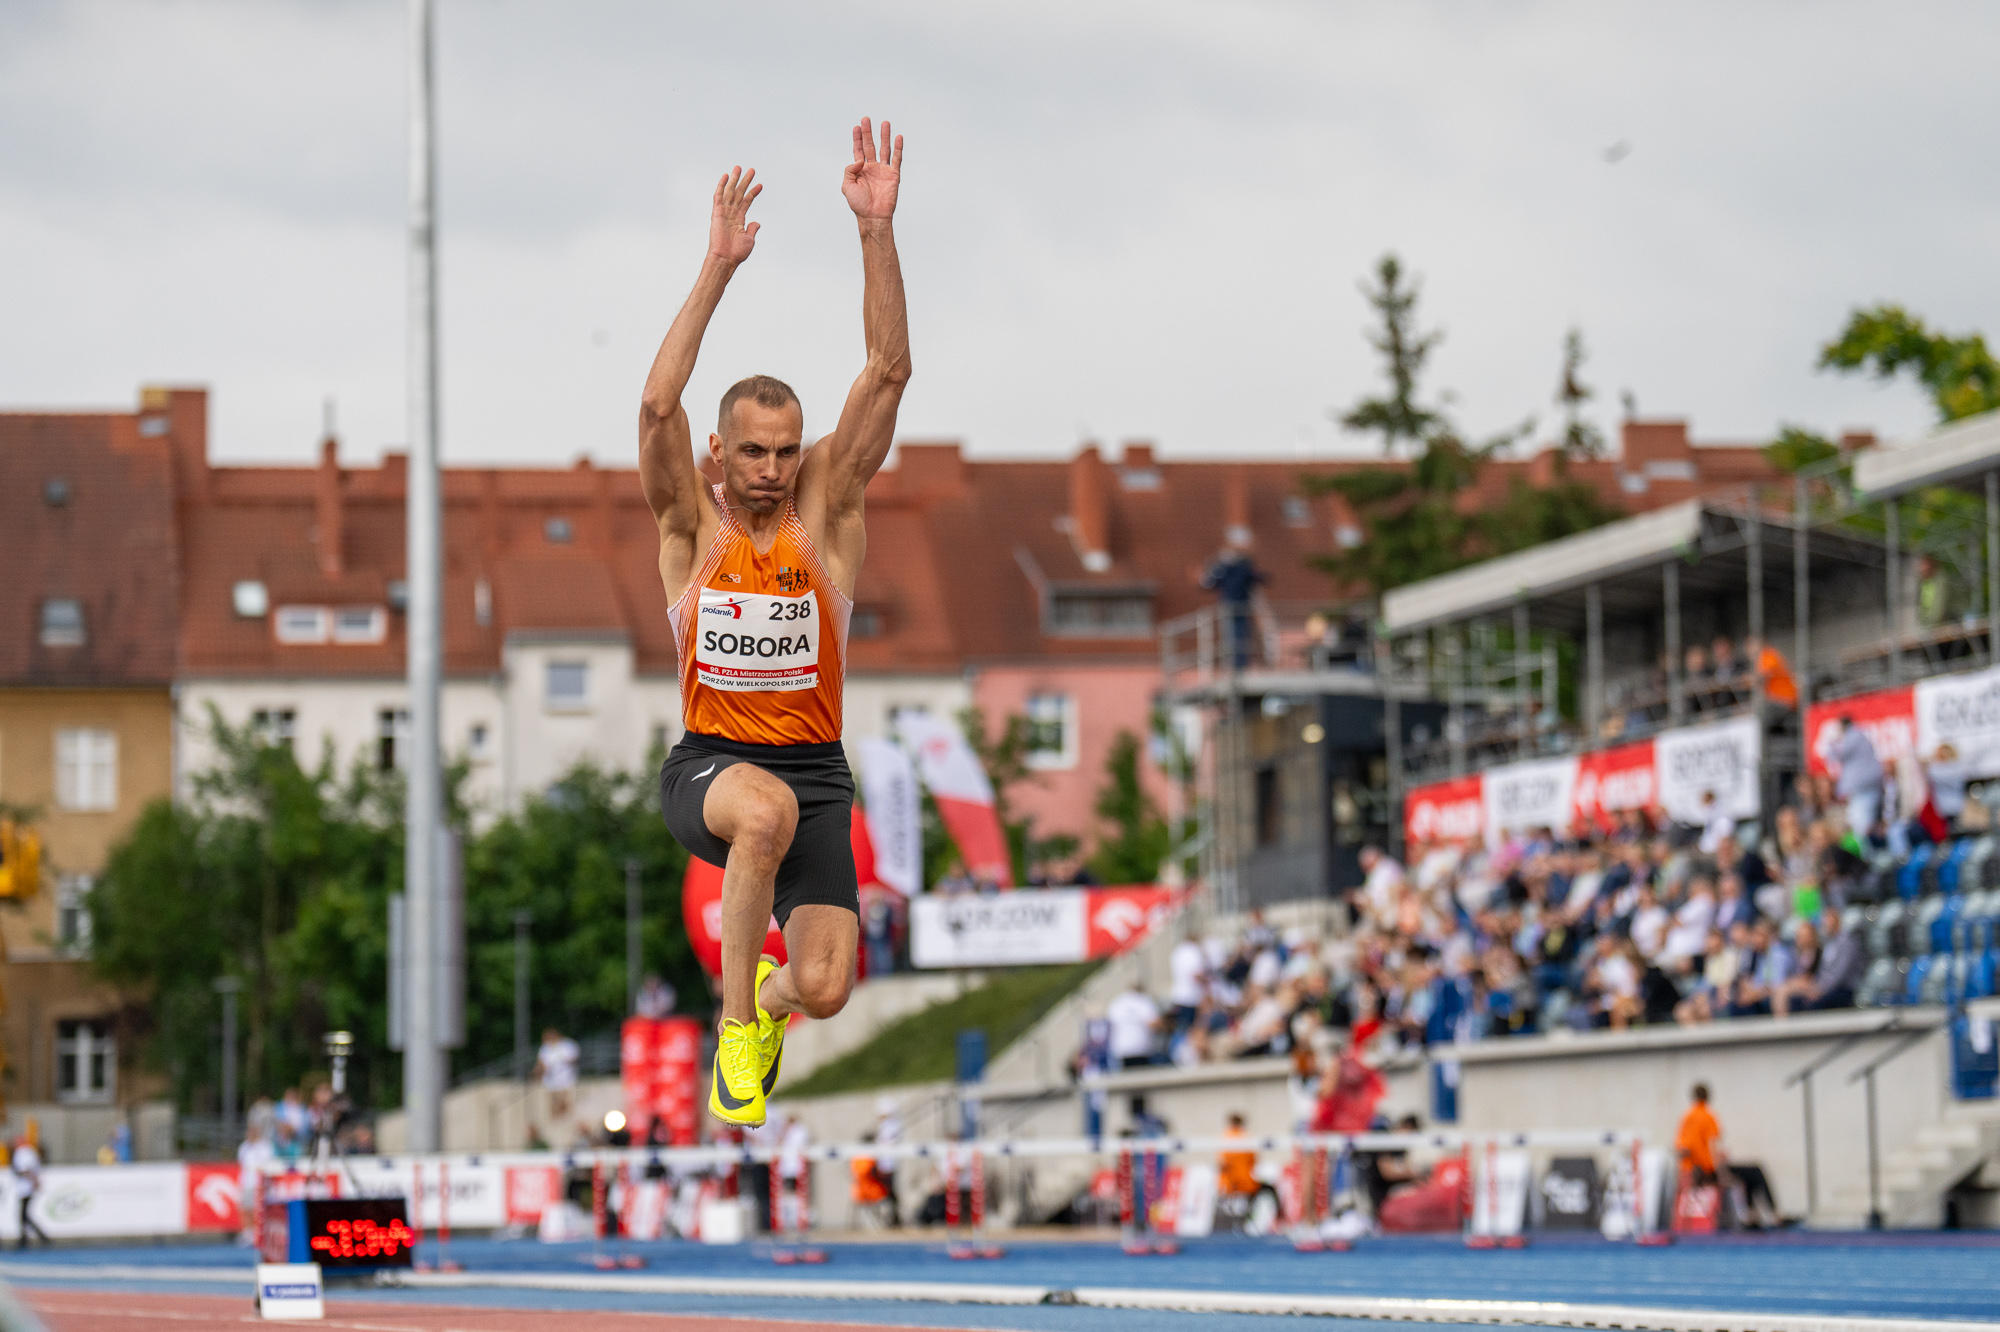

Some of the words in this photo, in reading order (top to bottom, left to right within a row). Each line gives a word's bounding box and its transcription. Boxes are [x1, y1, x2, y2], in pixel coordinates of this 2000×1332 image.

[720, 573, 741, 584] esa
[780, 579, 793, 588] TEAM
[702, 606, 733, 617] polanik
[768, 600, 811, 621] 238
[704, 630, 811, 658] SOBORA
[709, 666, 721, 674] 99.
[721, 669, 739, 677] PZLA
[739, 670, 783, 678] Mistrzostwa
[783, 668, 804, 677] Polski
[701, 674, 735, 686] GORZÓW
[736, 678, 794, 687] WIELKOPOLSKI
[794, 677, 812, 686] 2023
